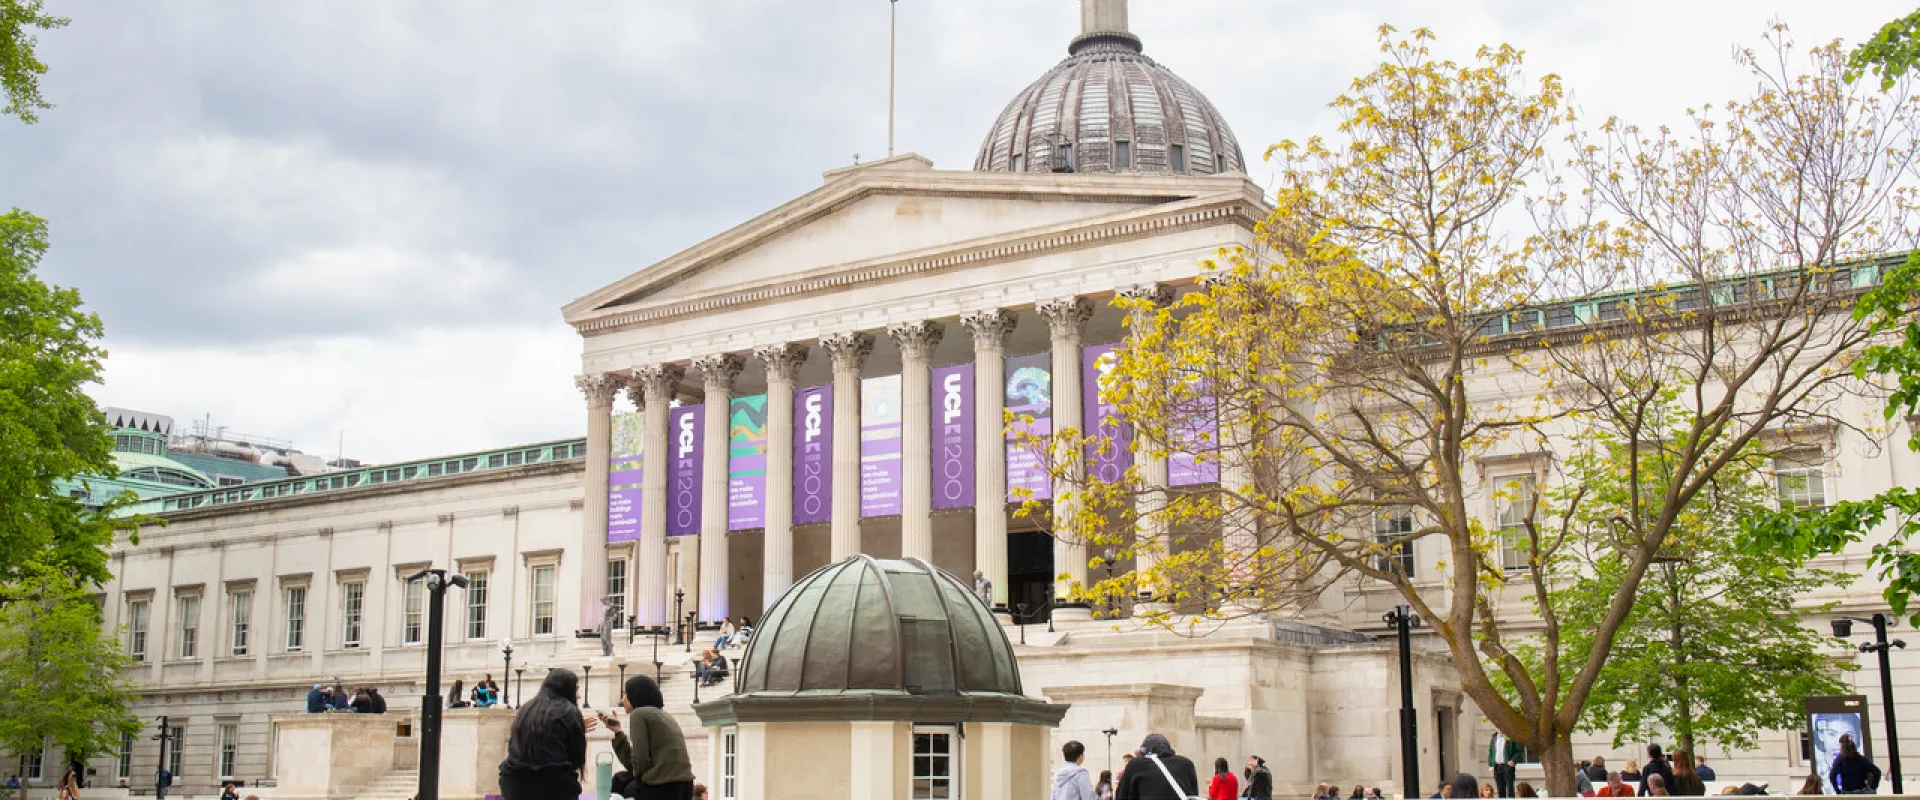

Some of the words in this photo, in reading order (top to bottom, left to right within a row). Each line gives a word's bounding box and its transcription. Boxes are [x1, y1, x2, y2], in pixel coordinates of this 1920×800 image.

[805, 394, 821, 442] UCL
[944, 374, 961, 424] UCL
[679, 413, 694, 458] UCL
[804, 462, 821, 515] 200
[944, 444, 962, 500] 200
[678, 477, 692, 528] 200
